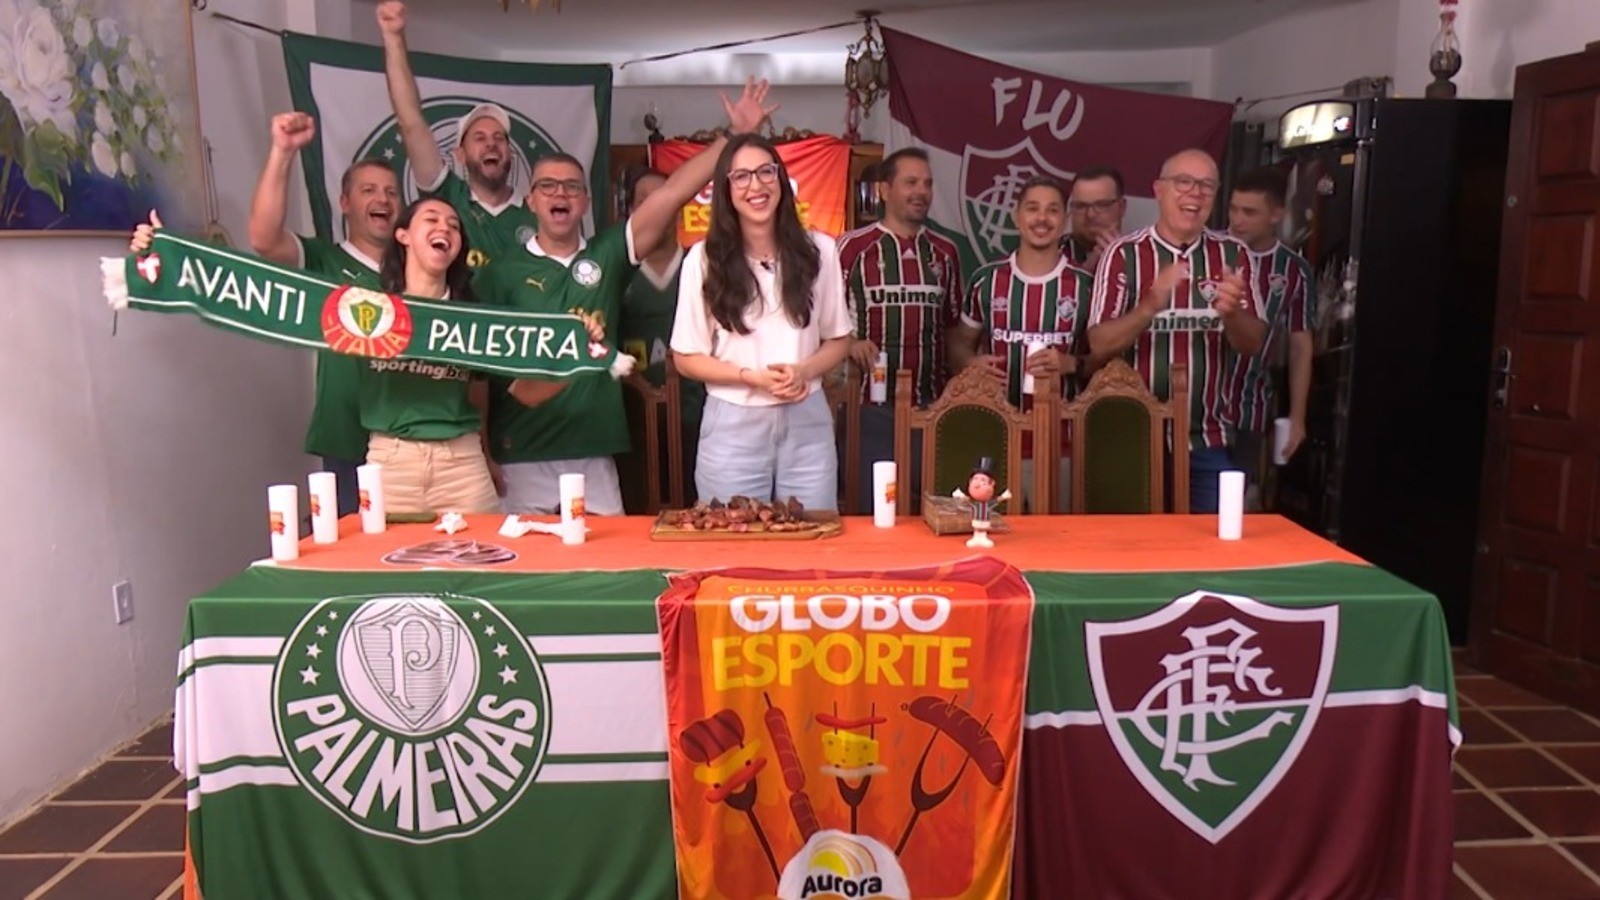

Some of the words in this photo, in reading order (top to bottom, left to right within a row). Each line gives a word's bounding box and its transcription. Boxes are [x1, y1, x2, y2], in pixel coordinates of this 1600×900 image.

[990, 77, 1084, 140] FLU
[177, 255, 305, 325] AVANTI
[428, 317, 579, 361] PALESTRA
[993, 328, 1073, 345] SUPERBET
[370, 359, 469, 380] sportingbe
[729, 594, 951, 633] GLOBO
[711, 632, 972, 691] ESPORTE
[286, 693, 538, 832] PALMEIRAS
[800, 874, 883, 899] Aurora
